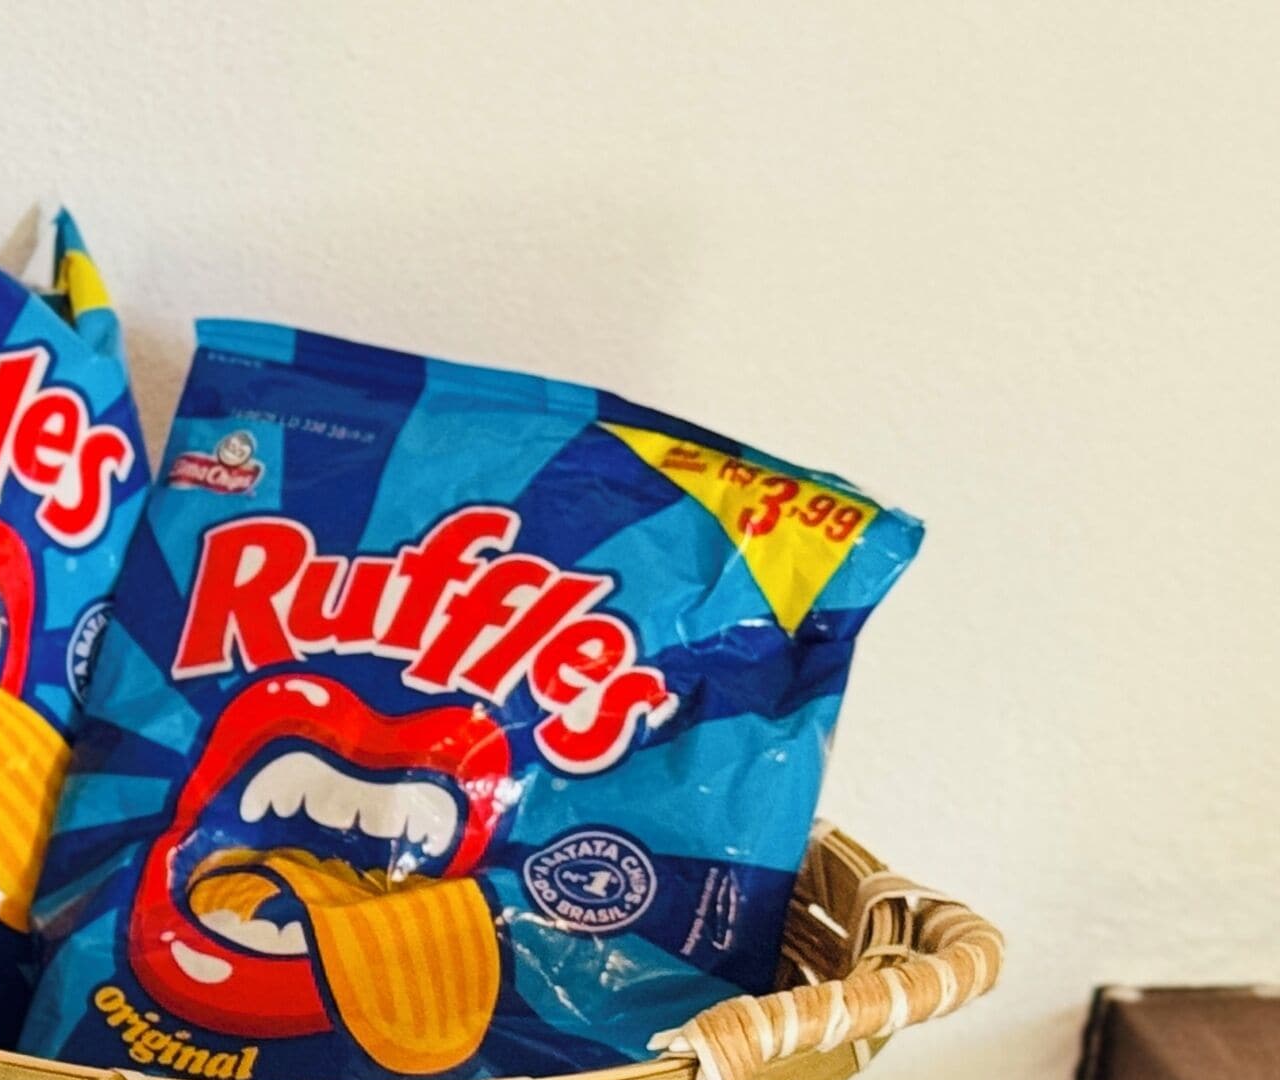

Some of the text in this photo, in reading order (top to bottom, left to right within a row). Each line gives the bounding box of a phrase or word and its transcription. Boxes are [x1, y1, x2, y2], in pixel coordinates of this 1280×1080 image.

[737, 475, 864, 543] 3,99
[172, 507, 678, 773] Ruffles
[555, 899, 626, 923] BRASIL
